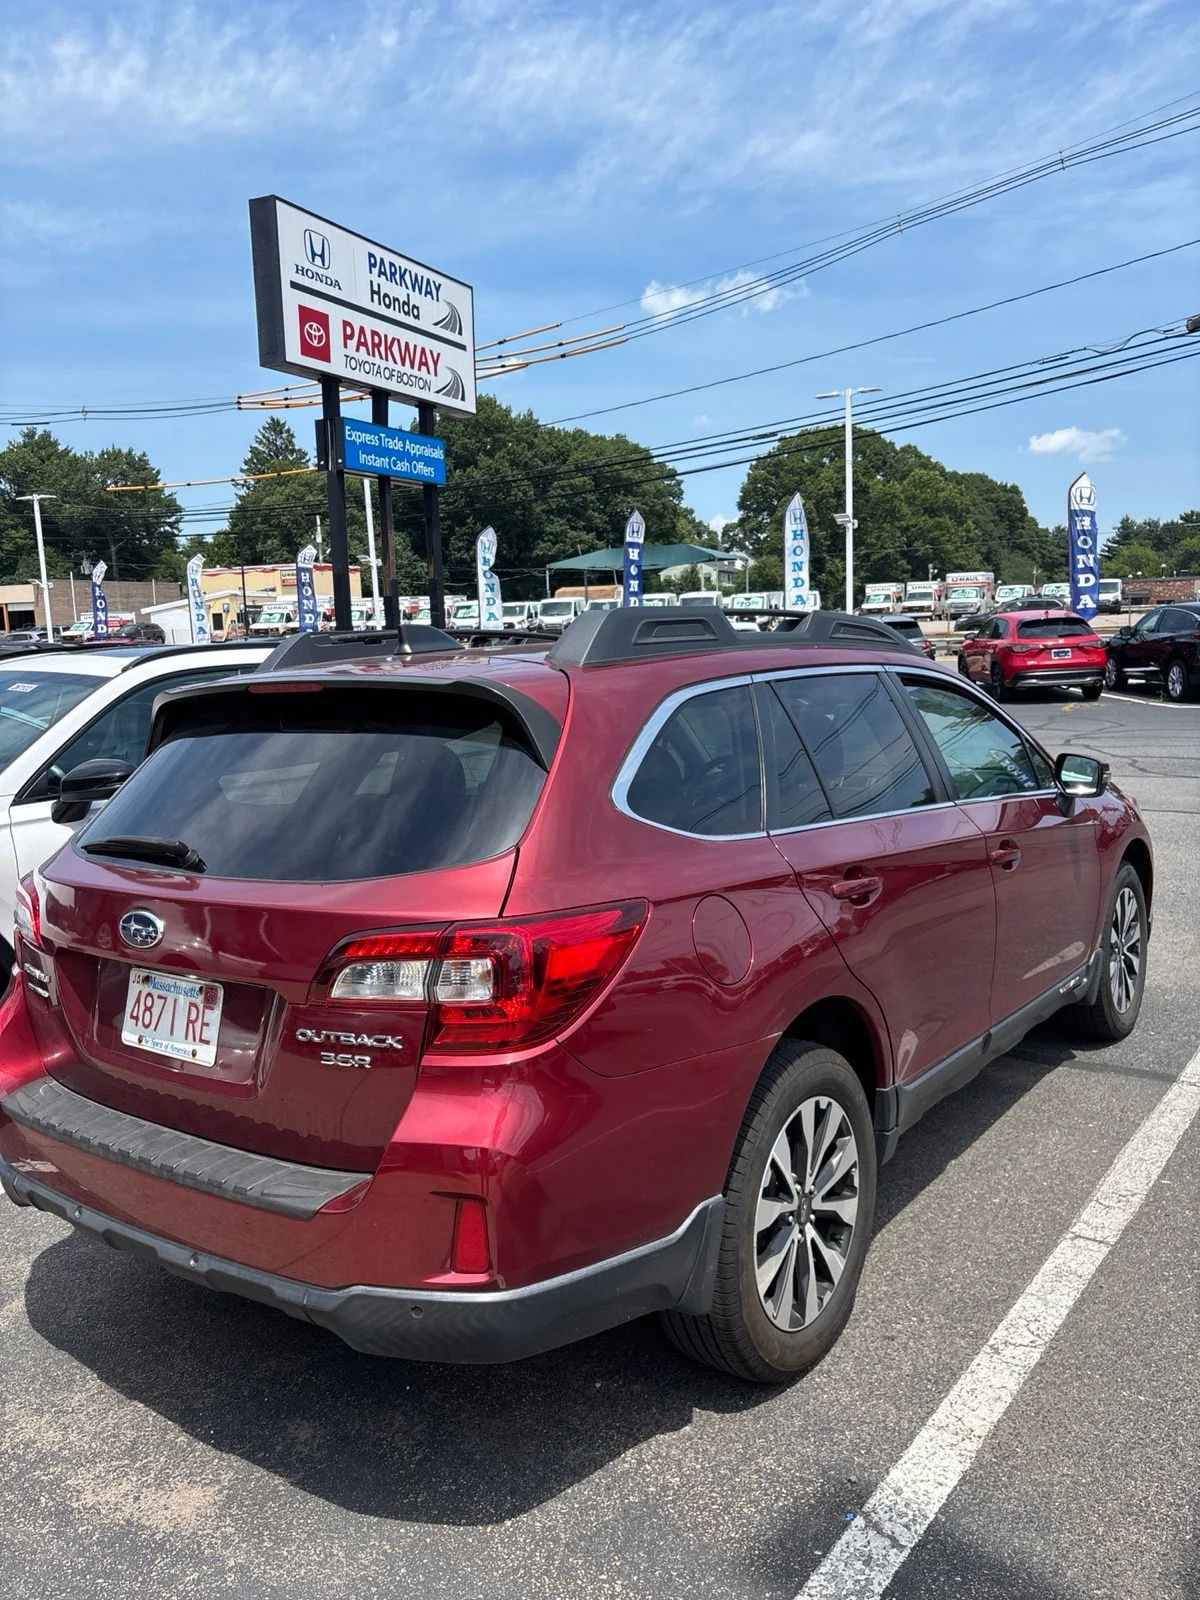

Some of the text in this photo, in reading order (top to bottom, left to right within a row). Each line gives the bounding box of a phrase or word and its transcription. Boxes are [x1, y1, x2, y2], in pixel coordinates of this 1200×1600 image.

[295, 264, 342, 291] HONDA
[368, 251, 442, 302] PARKWAY
[370, 280, 420, 320] Honda
[342, 319, 441, 377] PARKWAY
[344, 354, 432, 393] TOYOTA OF BOSTON
[345, 426, 445, 460] Express Trade Appraisals
[359, 450, 435, 478] Instant Cash Offers
[628, 548, 640, 607] HOND
[791, 528, 807, 606] HONDA
[1075, 516, 1097, 609] HONDA
[191, 578, 207, 634] HONDA
[301, 572, 315, 632] HOND
[482, 557, 499, 622] HONDA
[148, 976, 200, 999] Massachusetts
[129, 990, 177, 1037] 4871
[184, 1002, 215, 1046] RE
[295, 1027, 403, 1049] OUTBACK
